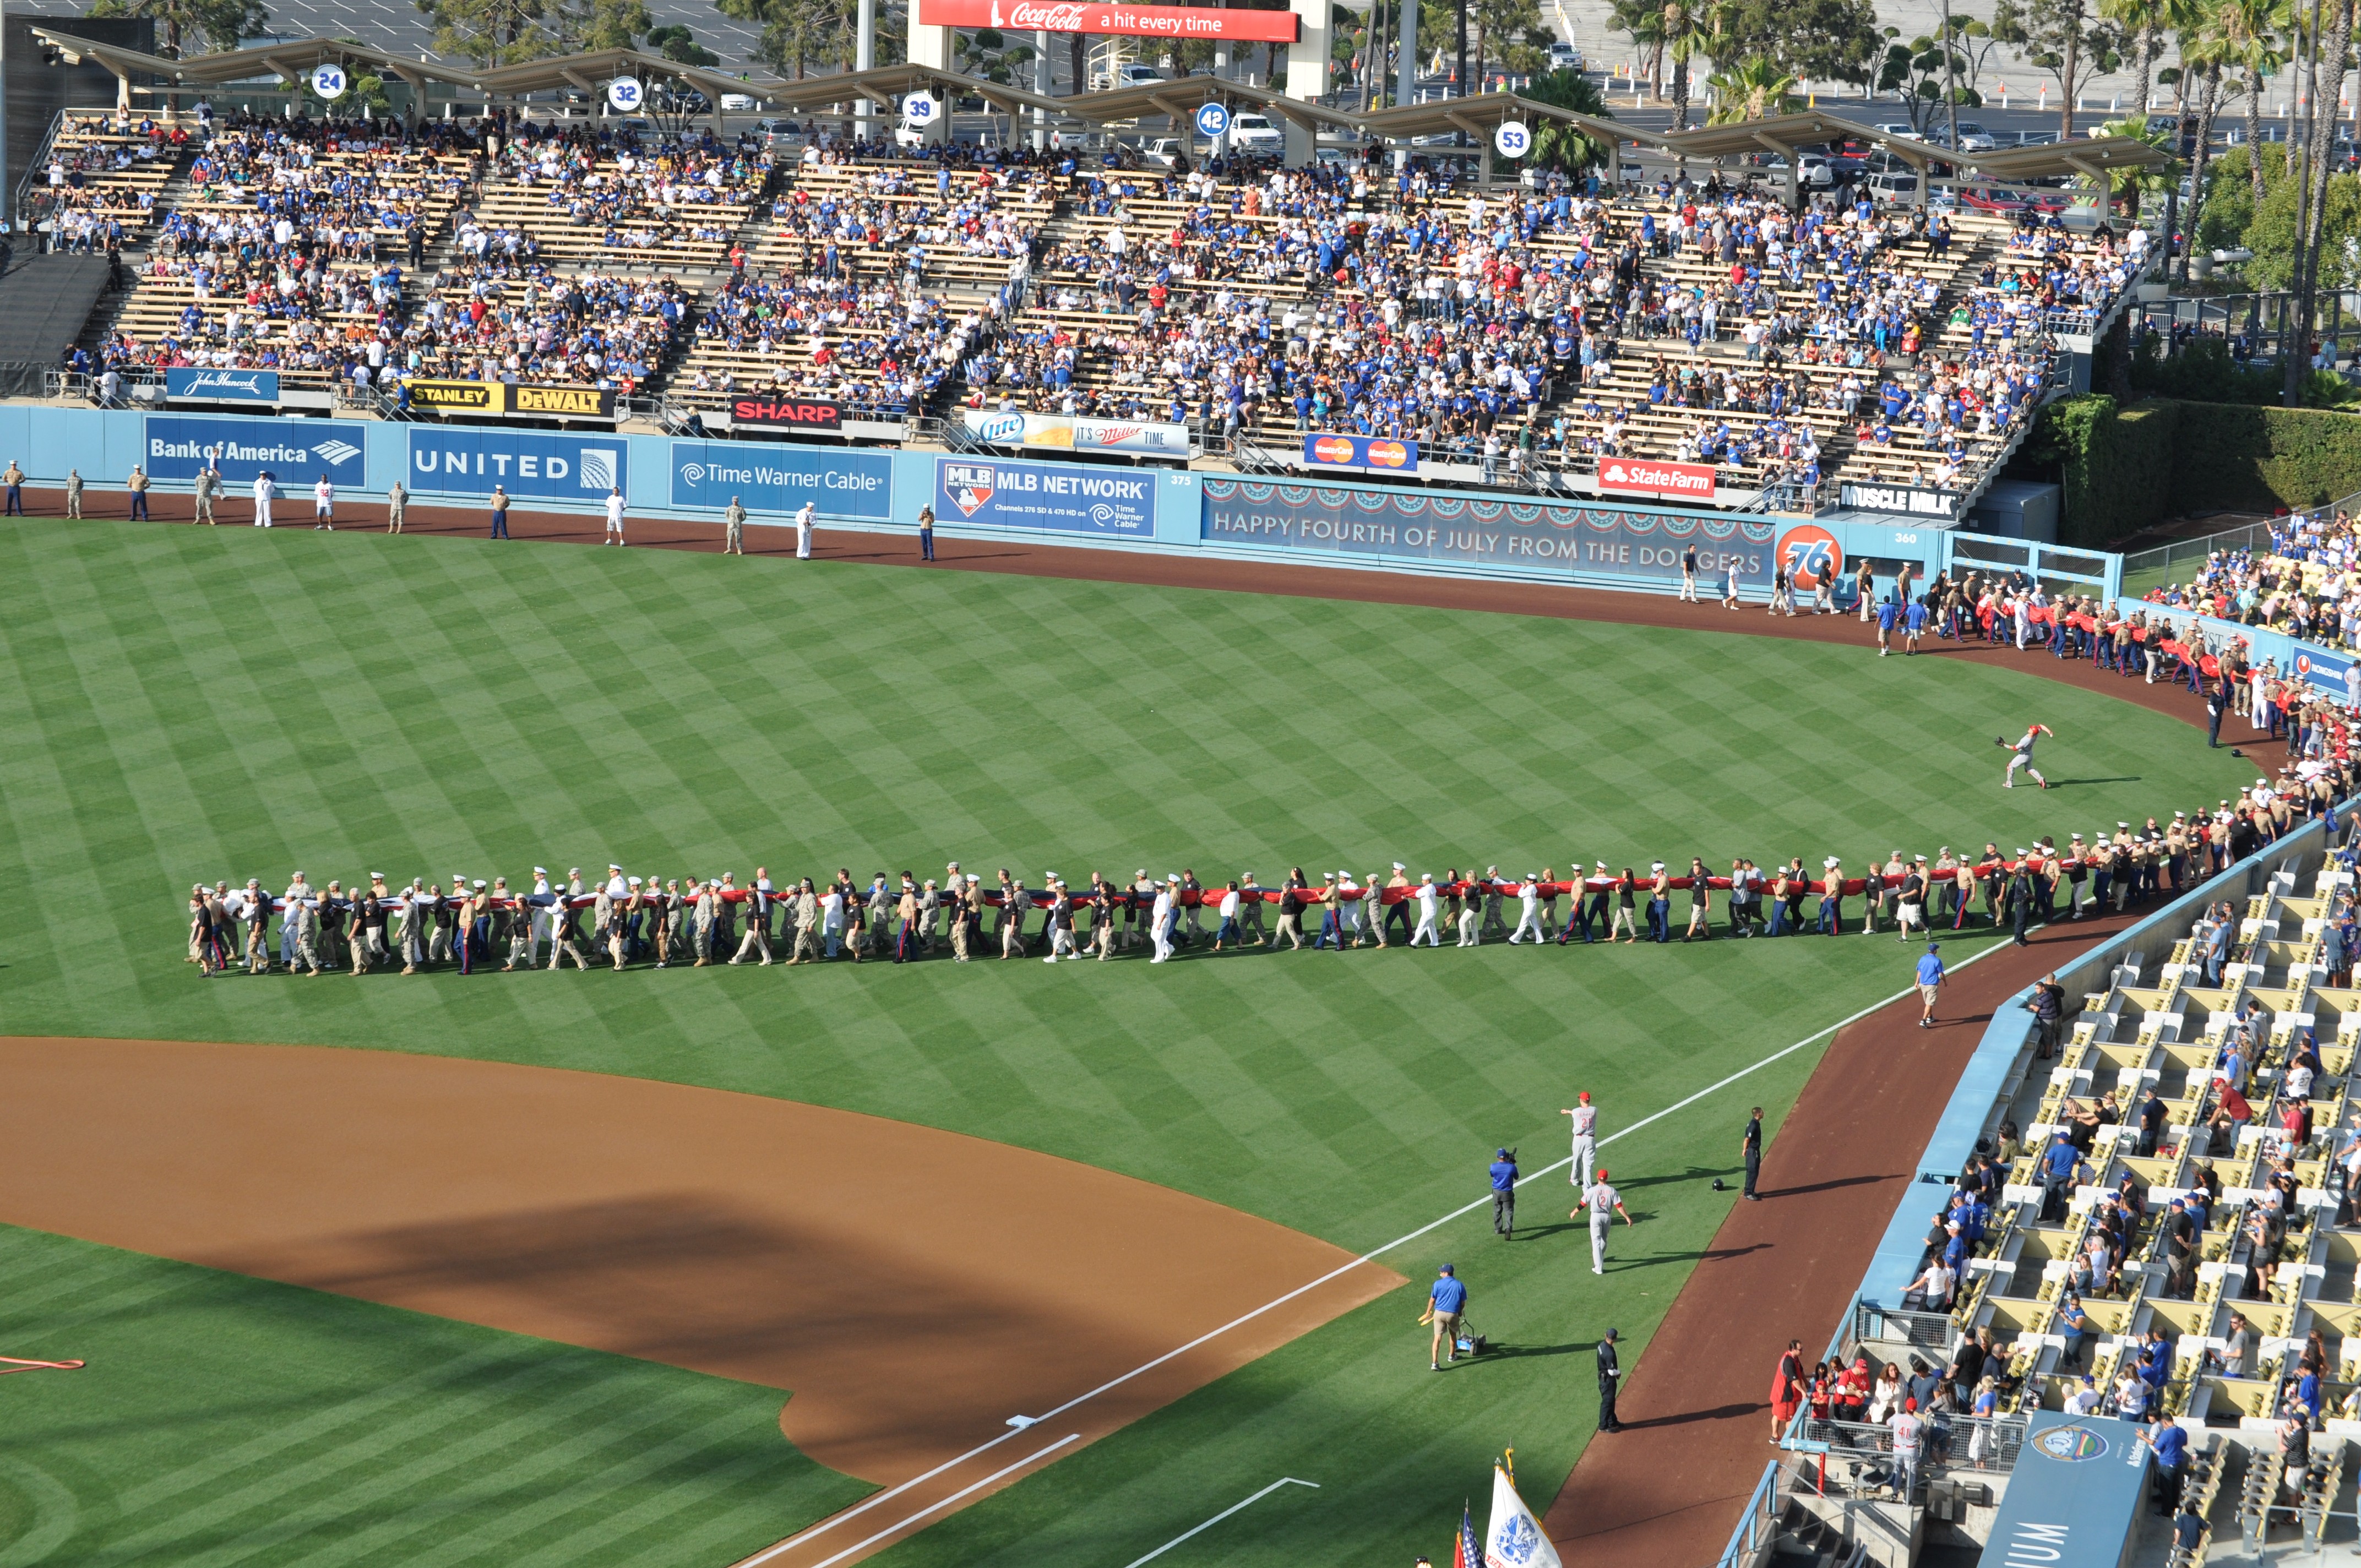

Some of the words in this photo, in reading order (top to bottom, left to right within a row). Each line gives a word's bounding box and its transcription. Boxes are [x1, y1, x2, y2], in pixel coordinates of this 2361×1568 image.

[1010, 2, 1086, 30] Coca-Cola
[1101, 15, 1109, 26] a
[1114, 12, 1135, 28] hit
[1139, 17, 1182, 33] every
[1187, 17, 1222, 32] time
[319, 73, 340, 89] 24
[616, 85, 637, 102] 32
[910, 101, 931, 117] 39
[1201, 111, 1225, 129] 42
[1503, 132, 1524, 149] 53
[184, 371, 217, 396] John
[215, 371, 260, 394] Hancock
[414, 388, 486, 404] STANLEY
[736, 402, 836, 422] SHARP
[987, 418, 1019, 441] Lite
[1077, 427, 1092, 440] IT'S
[1095, 427, 1143, 444] Miller
[1145, 431, 1164, 445] TIME
[151, 439, 200, 458] Bank
[203, 441, 224, 459] of
[226, 441, 306, 462] America
[1315, 444, 1353, 456] MasterCard
[1368, 448, 1406, 460] MasterCard
[416, 450, 568, 479] UNITED
[706, 464, 751, 483] Time
[755, 466, 822, 487] Warner
[825, 471, 876, 491] Cable
[948, 467, 991, 483] MLB
[1171, 476, 1191, 486] 375
[1629, 467, 1671, 486] State
[1670, 471, 1709, 489] Farm
[998, 472, 1037, 491] MLB
[1043, 475, 1143, 499] NETWORK
[995, 504, 1023, 512] Channels
[1841, 487, 1906, 511] MUSCLE
[1908, 491, 1953, 515] MILK
[1114, 519, 1137, 529] Cable
[1115, 513, 1144, 521] Warner
[1214, 512, 1292, 535] HAPPY
[1301, 518, 1396, 544] FOURTH
[1405, 528, 1436, 547] OF
[1444, 531, 1499, 553] JULY
[1508, 535, 1577, 560] FROM
[1586, 542, 1630, 563] THE
[1895, 532, 1917, 544] 360
[1785, 539, 1834, 578] 76
[2311, 663, 2343, 680] NONGSHIM
[1898, 1426, 1911, 1440] 41
